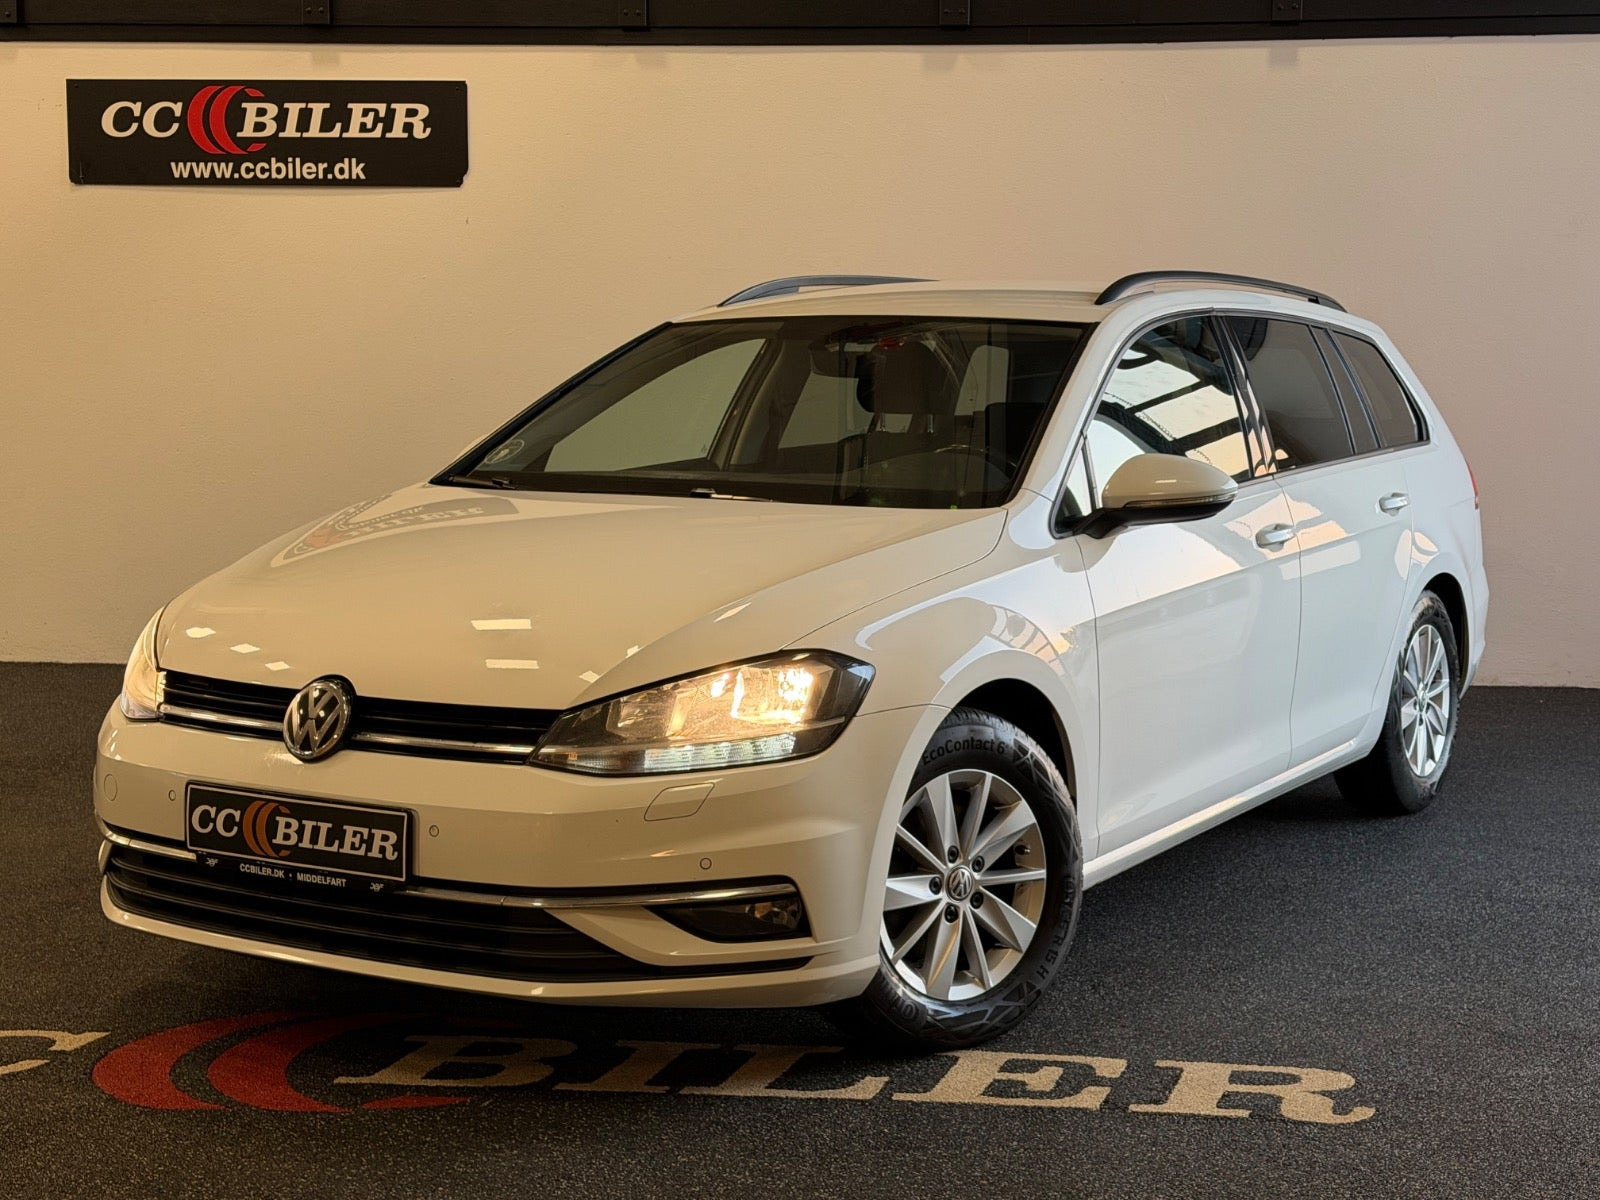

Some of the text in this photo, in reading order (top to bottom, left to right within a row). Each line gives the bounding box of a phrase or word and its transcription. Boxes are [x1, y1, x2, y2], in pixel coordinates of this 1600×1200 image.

[101, 101, 432, 139] CC BILER
[170, 157, 366, 180] www.ccbiler.dk
[922, 737, 1006, 765] EcoContact 6
[191, 804, 398, 861] CC BILER
[239, 863, 347, 888] CCBILER.DK MIDDELFART
[333, 1033, 1376, 1125] BILER
